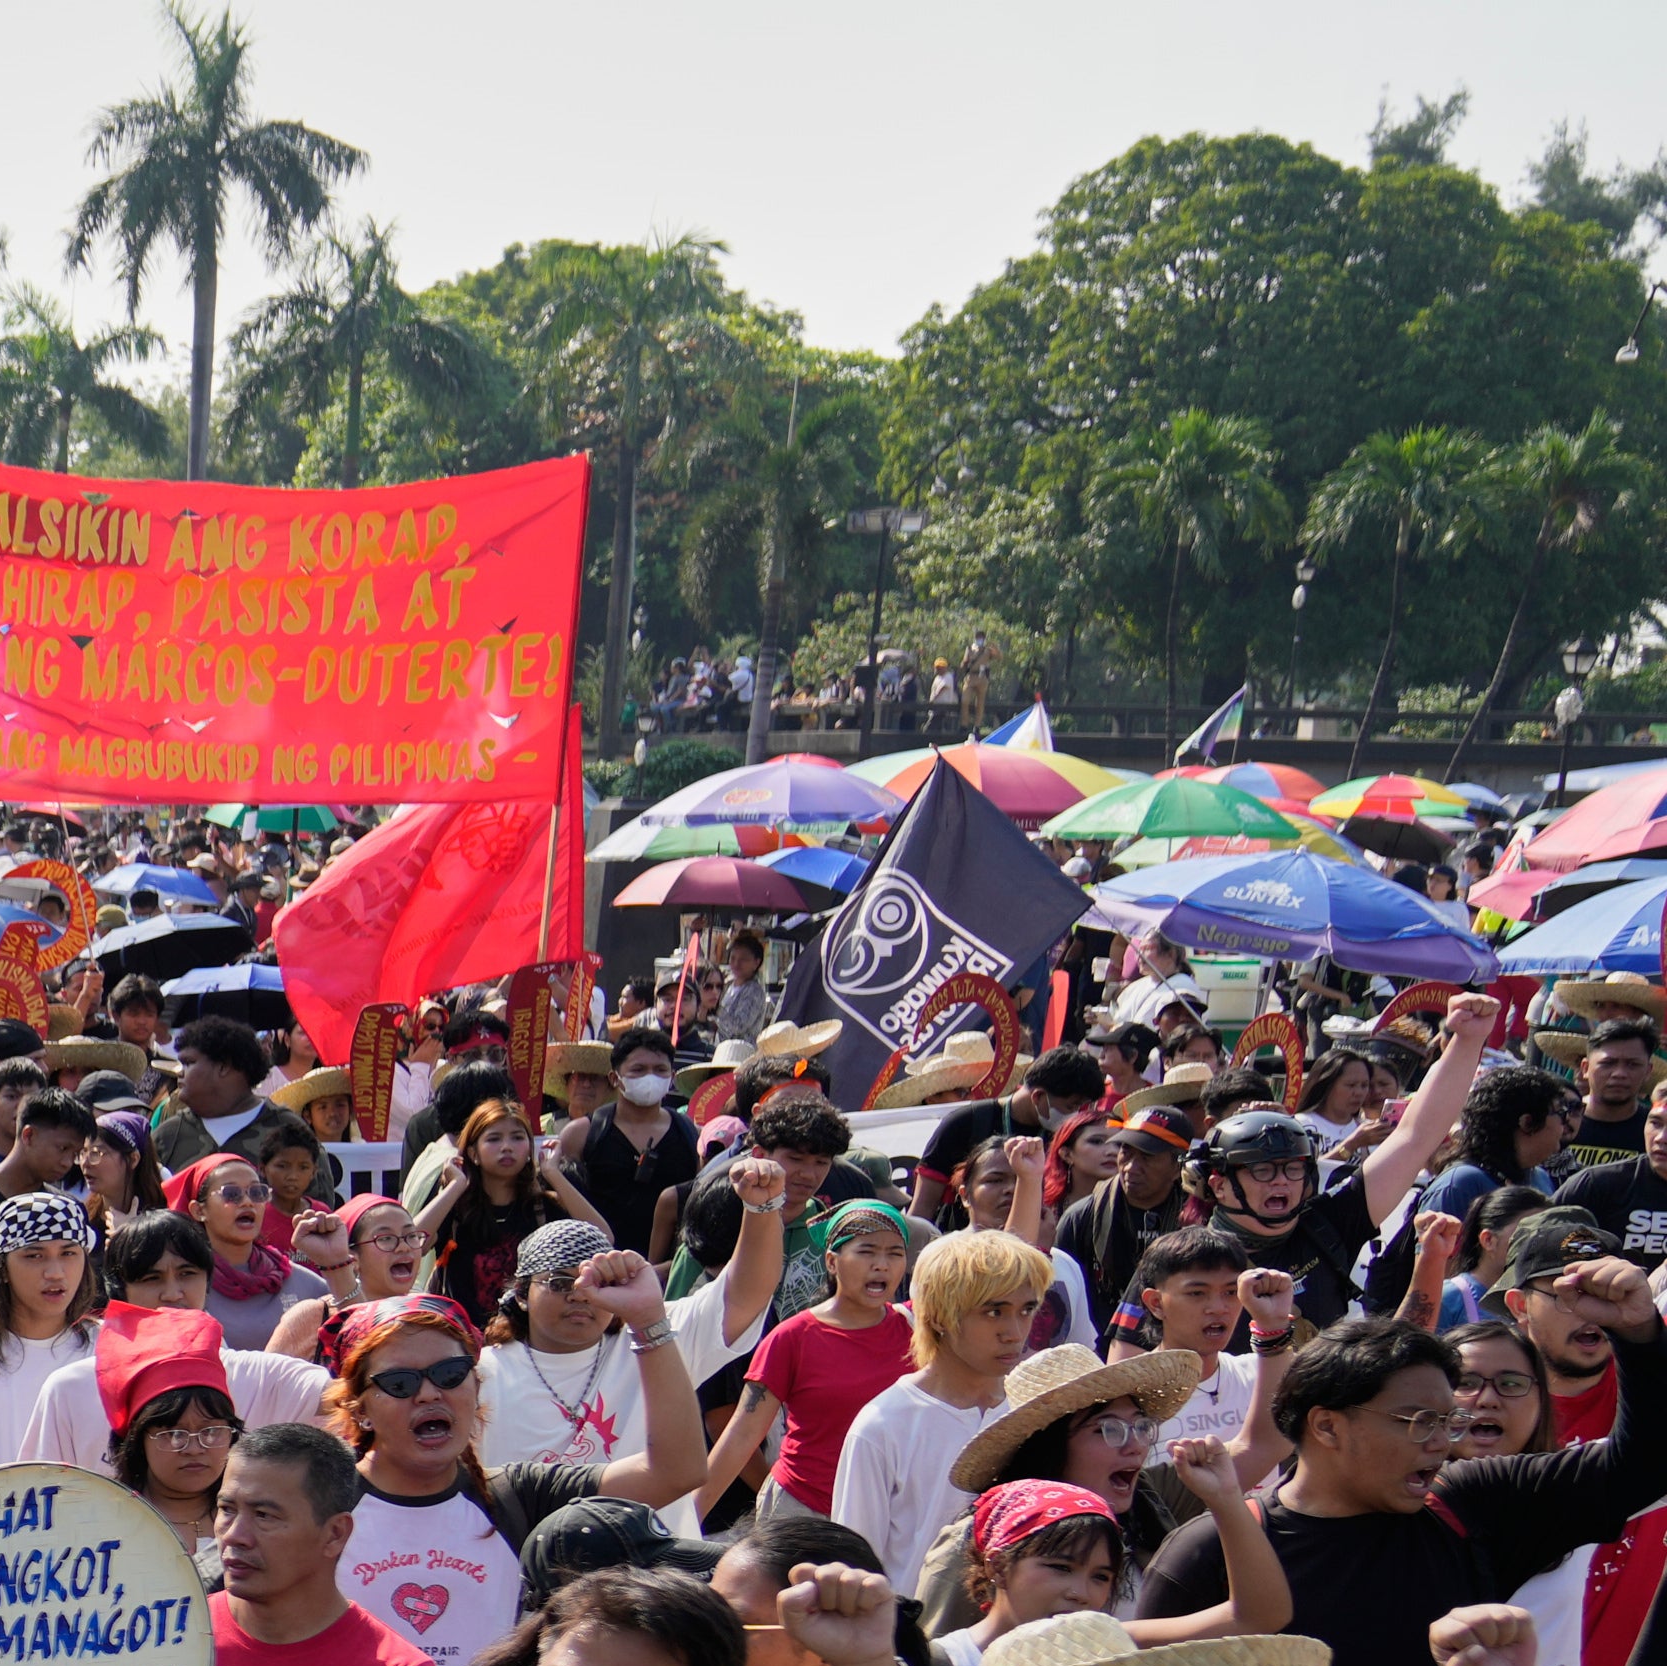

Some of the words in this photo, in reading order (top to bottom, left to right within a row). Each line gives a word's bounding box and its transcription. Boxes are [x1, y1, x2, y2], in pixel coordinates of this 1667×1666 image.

[166, 506, 267, 575] ANG
[289, 503, 472, 575] KORAP,
[171, 573, 381, 636] PASISTA
[401, 566, 476, 631] AT
[82, 631, 562, 707] MARCOS-DUTERTE!
[58, 735, 259, 782] MAGBUBUKID
[273, 743, 317, 783] NG
[327, 738, 495, 786] PILIPINAS
[1223, 885, 1306, 909] SUNTEX
[352, 1550, 420, 1586] Broken
[426, 1548, 489, 1584] Hearts
